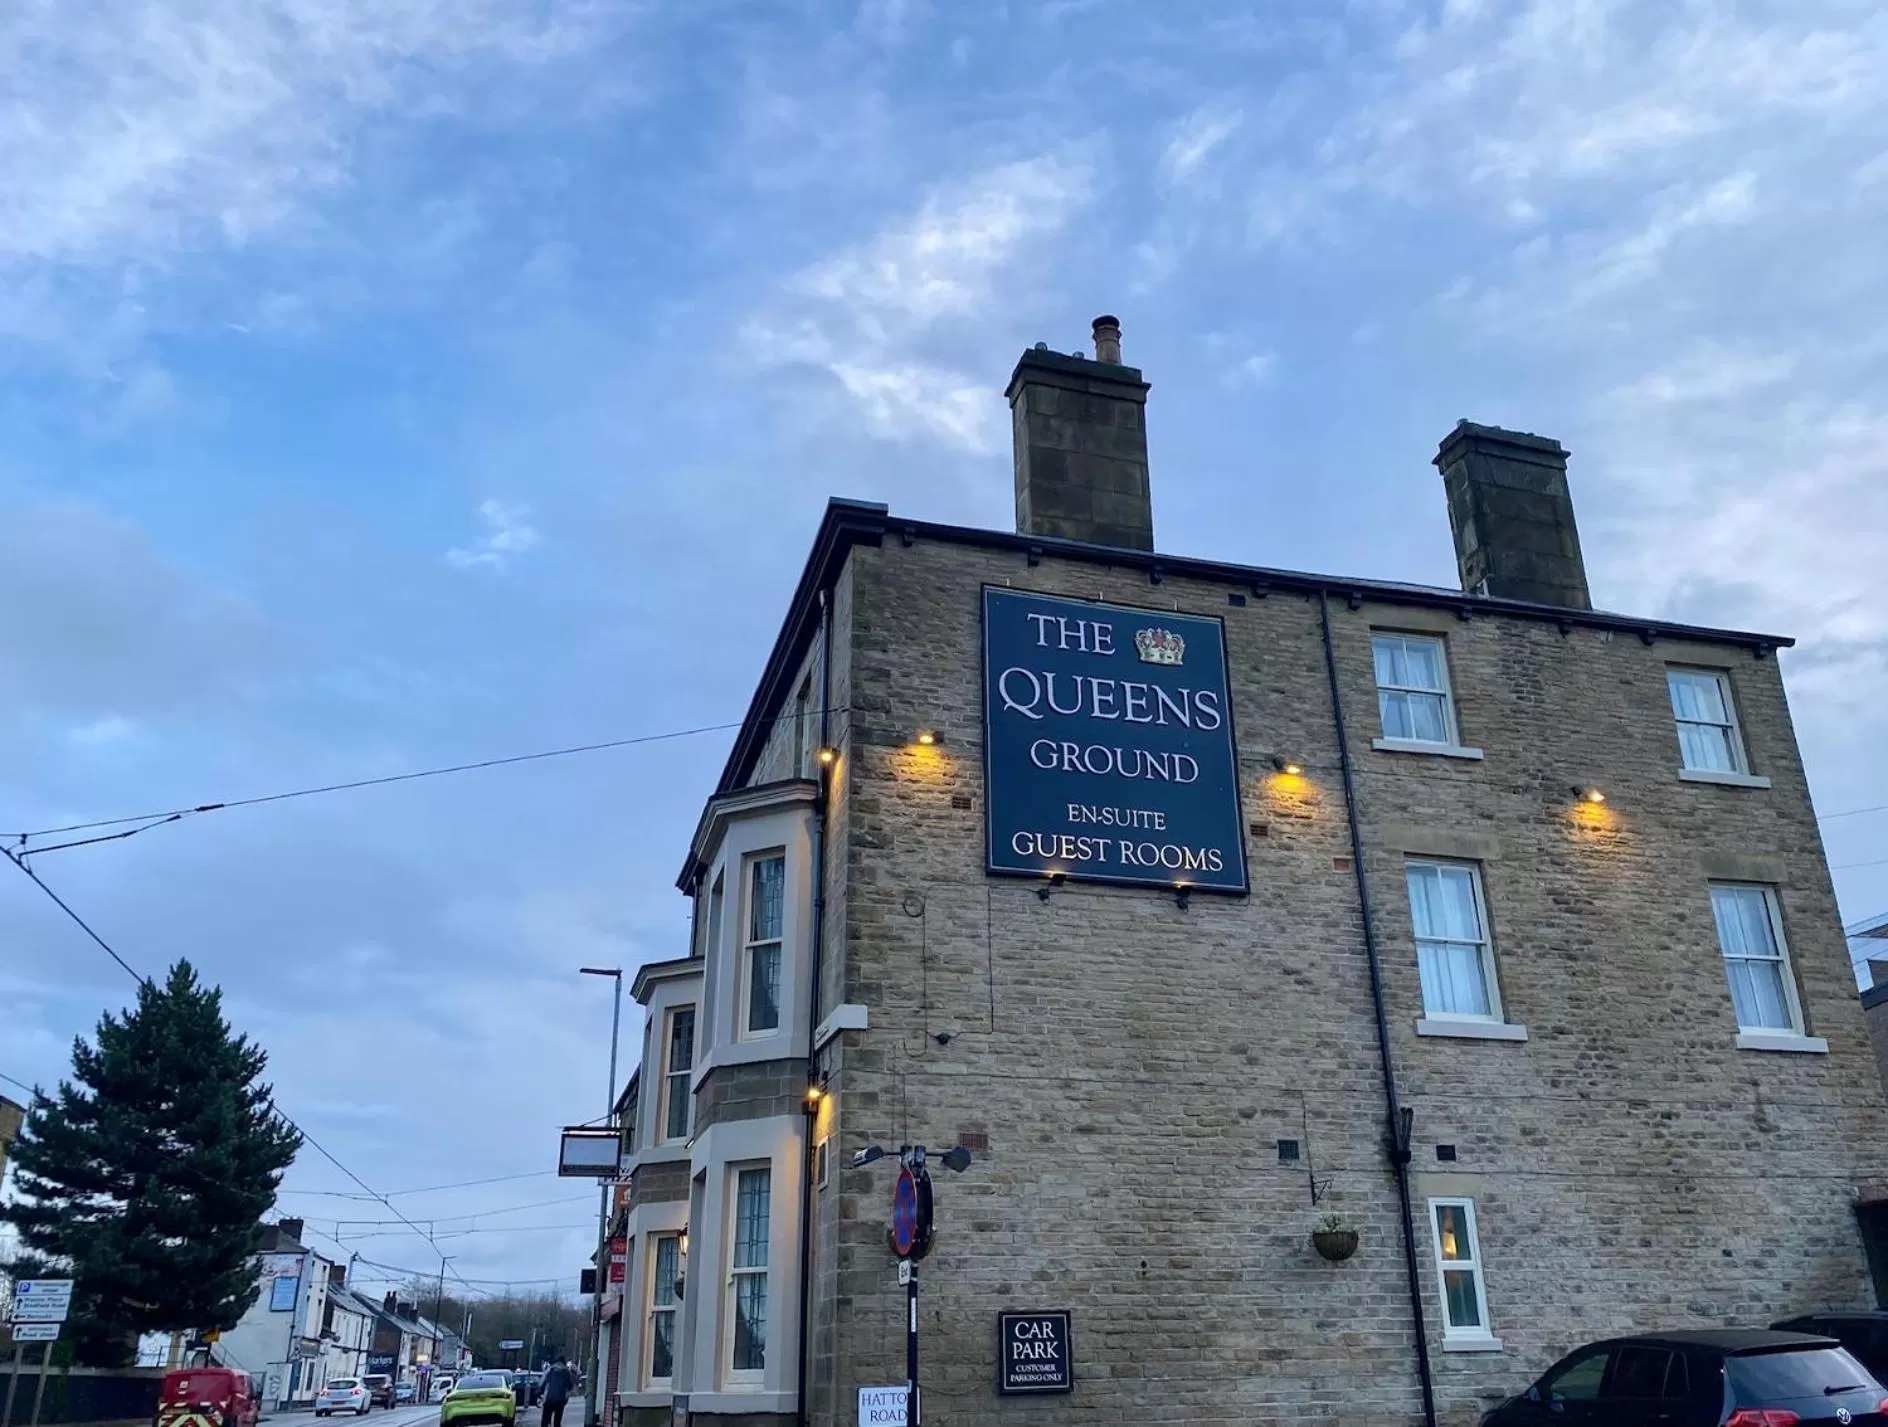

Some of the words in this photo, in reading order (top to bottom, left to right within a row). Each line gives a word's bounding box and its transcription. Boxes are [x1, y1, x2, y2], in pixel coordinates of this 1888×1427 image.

[1027, 613, 1116, 656] THE
[998, 667, 1221, 731] QUEENS
[1030, 739, 1199, 784] GROUND
[1067, 803, 1167, 831] EN-SUITE
[1011, 831, 1112, 862] GUEST
[1119, 840, 1223, 872] ROOMS
[1015, 1321, 1055, 1339] CAR
[1012, 1341, 1059, 1360] PARK
[1015, 1363, 1056, 1373] CUSTOMER
[1010, 1374, 1043, 1383] PARKING
[1043, 1373, 1063, 1382] ONLY
[861, 1392, 908, 1406] HATTO
[870, 1409, 908, 1422] ROAD
